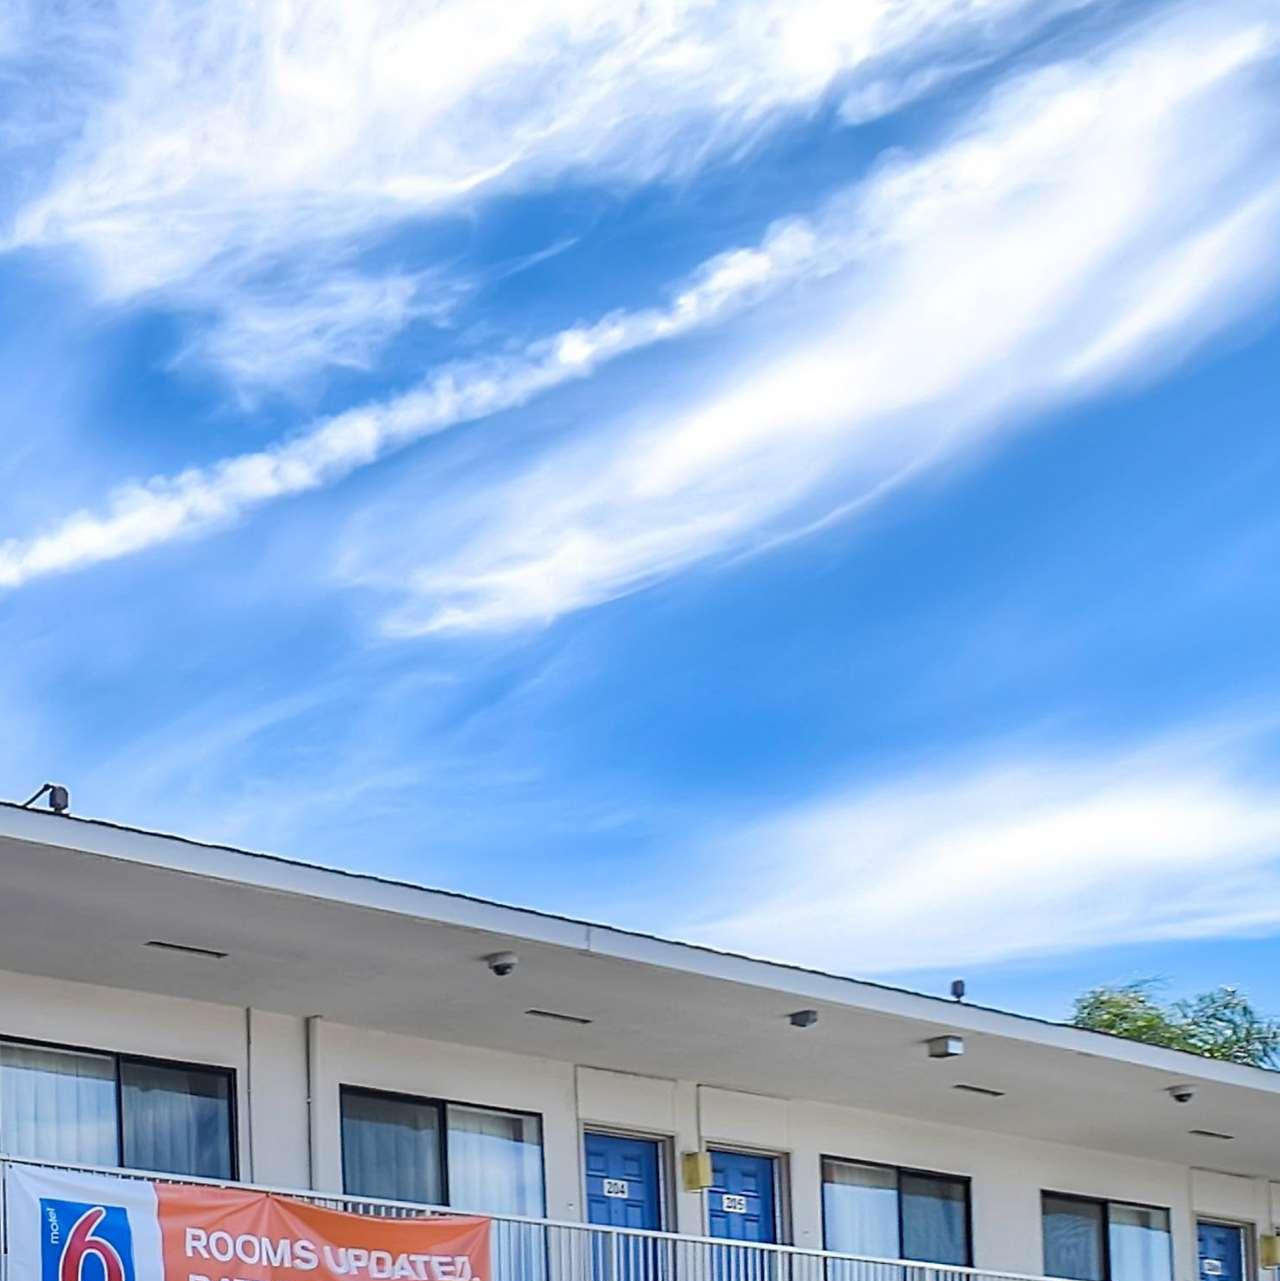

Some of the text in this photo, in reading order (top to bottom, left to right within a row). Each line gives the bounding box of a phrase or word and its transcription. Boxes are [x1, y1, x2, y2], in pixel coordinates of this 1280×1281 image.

[606, 1181, 626, 1195] 204
[46, 1207, 59, 1244] motel
[185, 1227, 318, 1270] ROOMS
